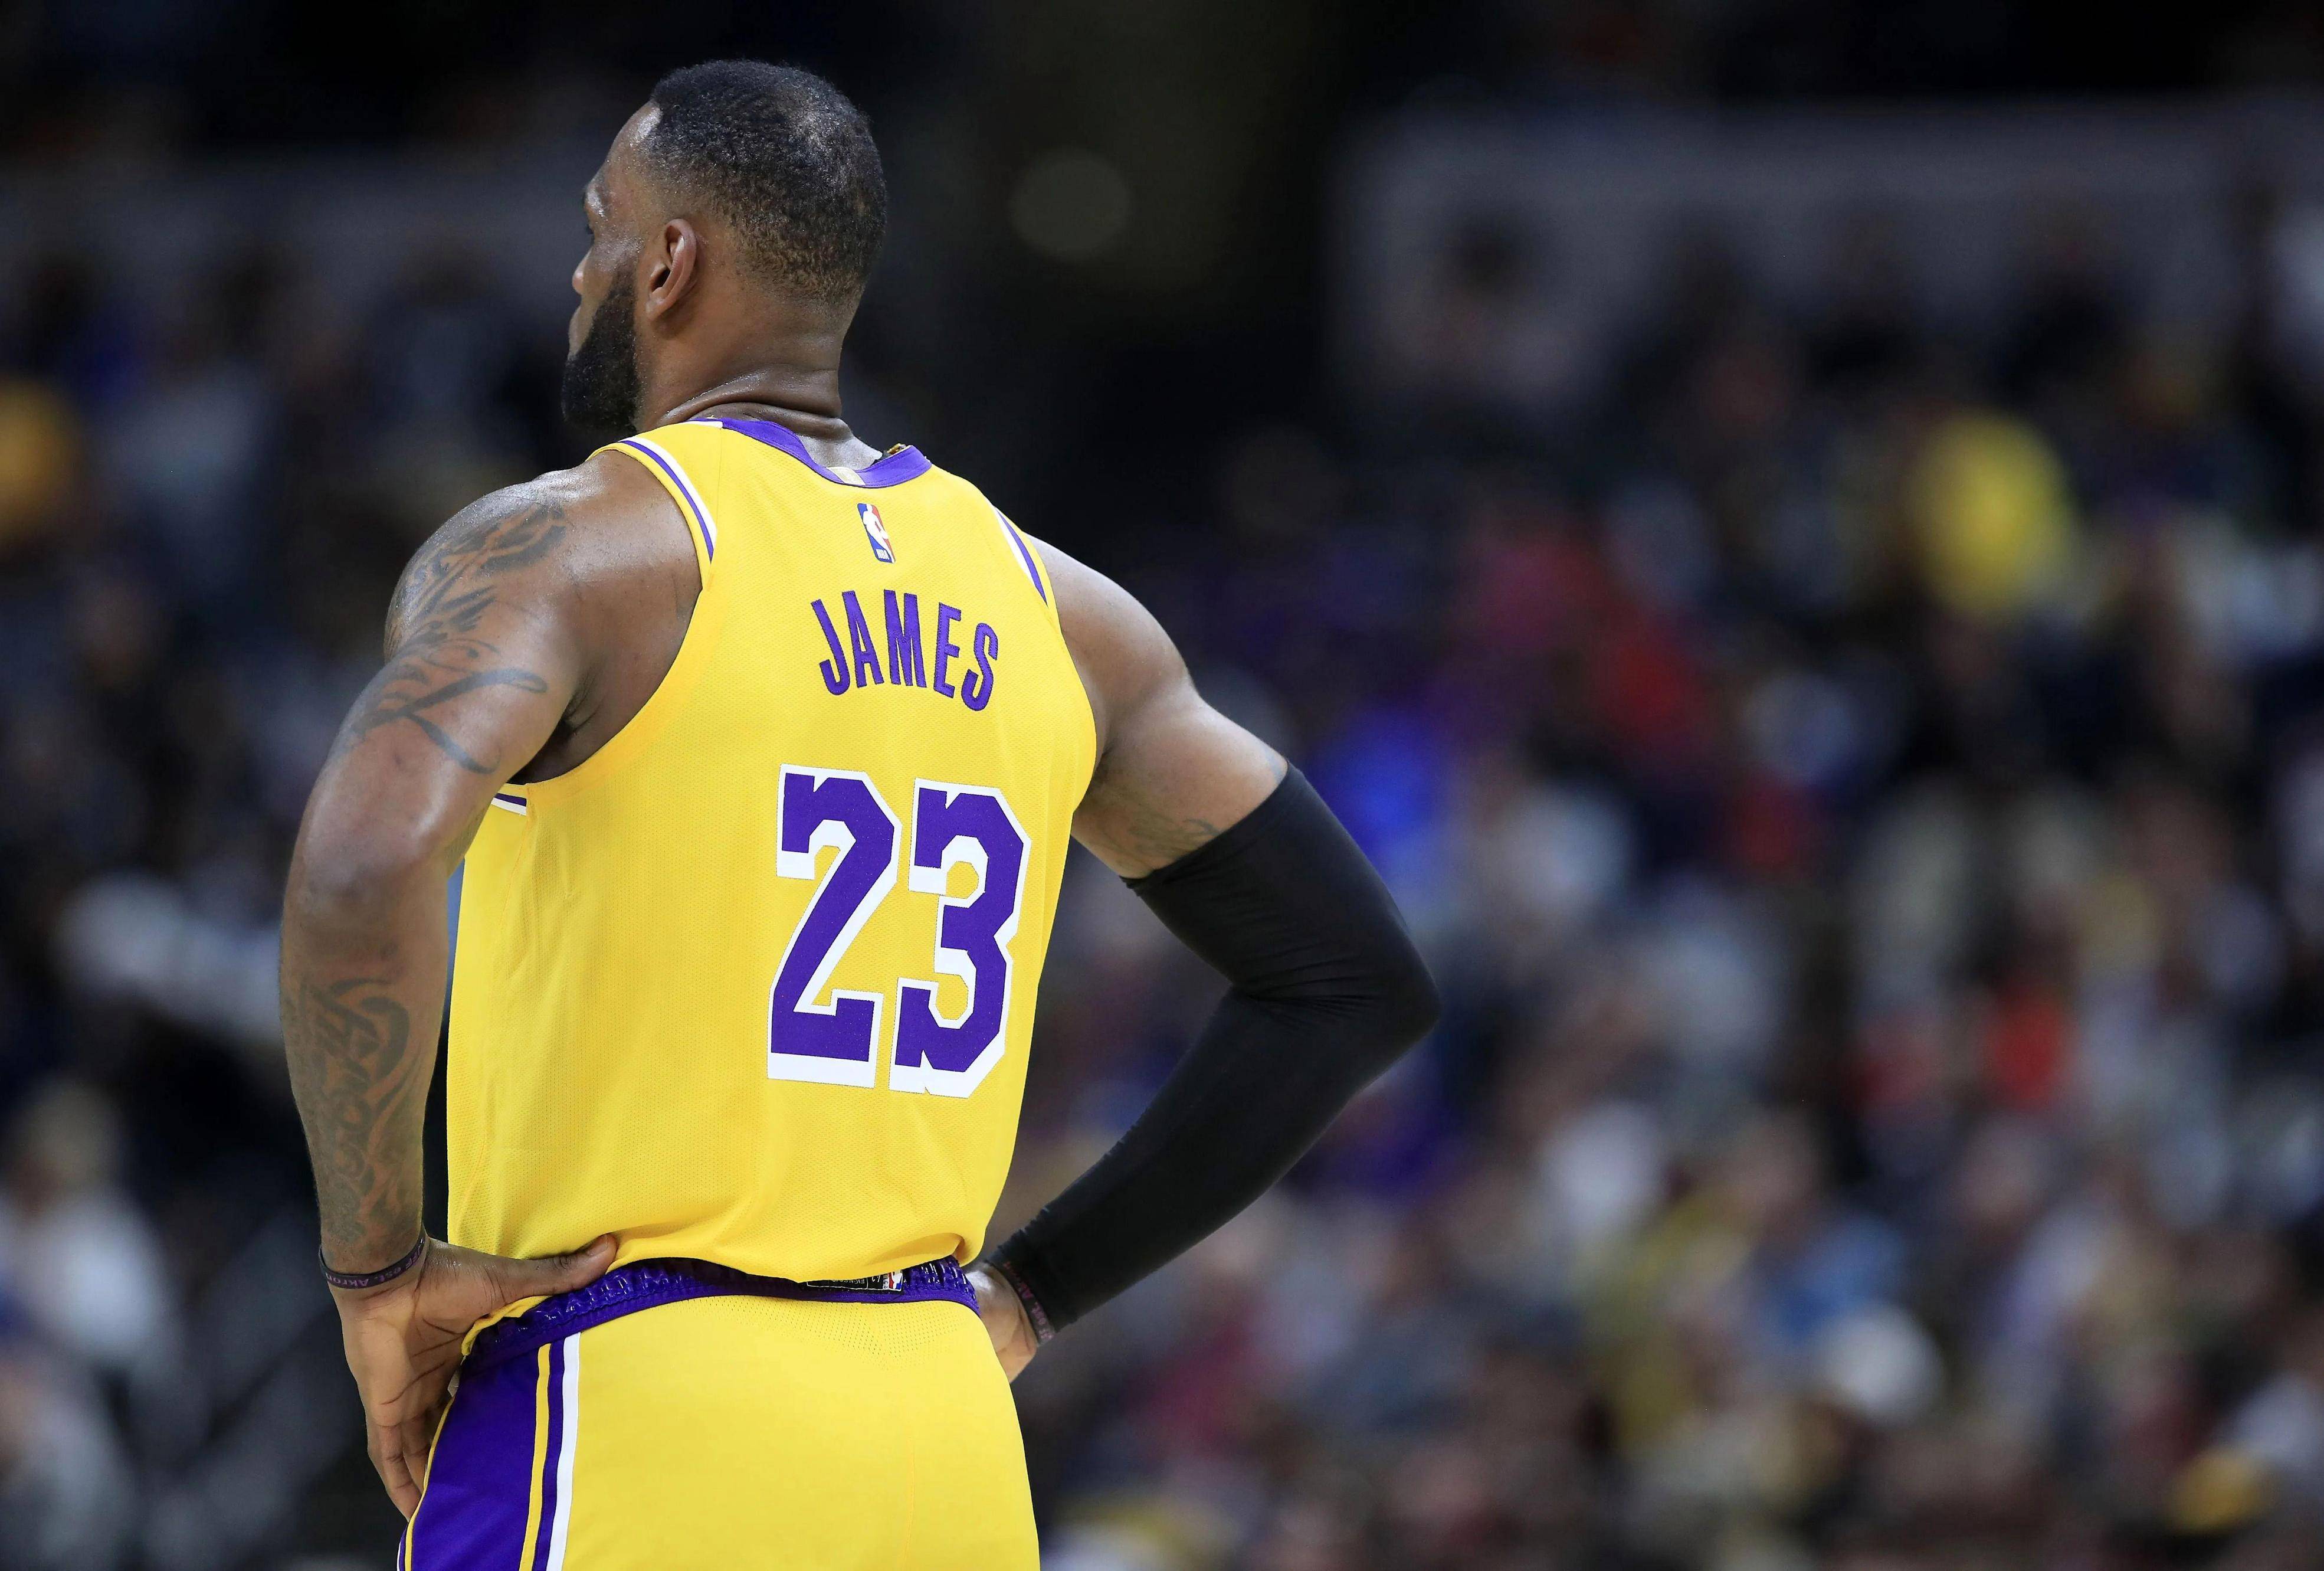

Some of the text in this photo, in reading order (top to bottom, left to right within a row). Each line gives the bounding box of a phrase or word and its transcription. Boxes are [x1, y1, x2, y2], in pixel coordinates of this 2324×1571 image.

[875, 548, 890, 560] NBA
[811, 589, 998, 711] JAMES
[767, 763, 1032, 1098] 23
[326, 1272, 369, 1287] Akron
